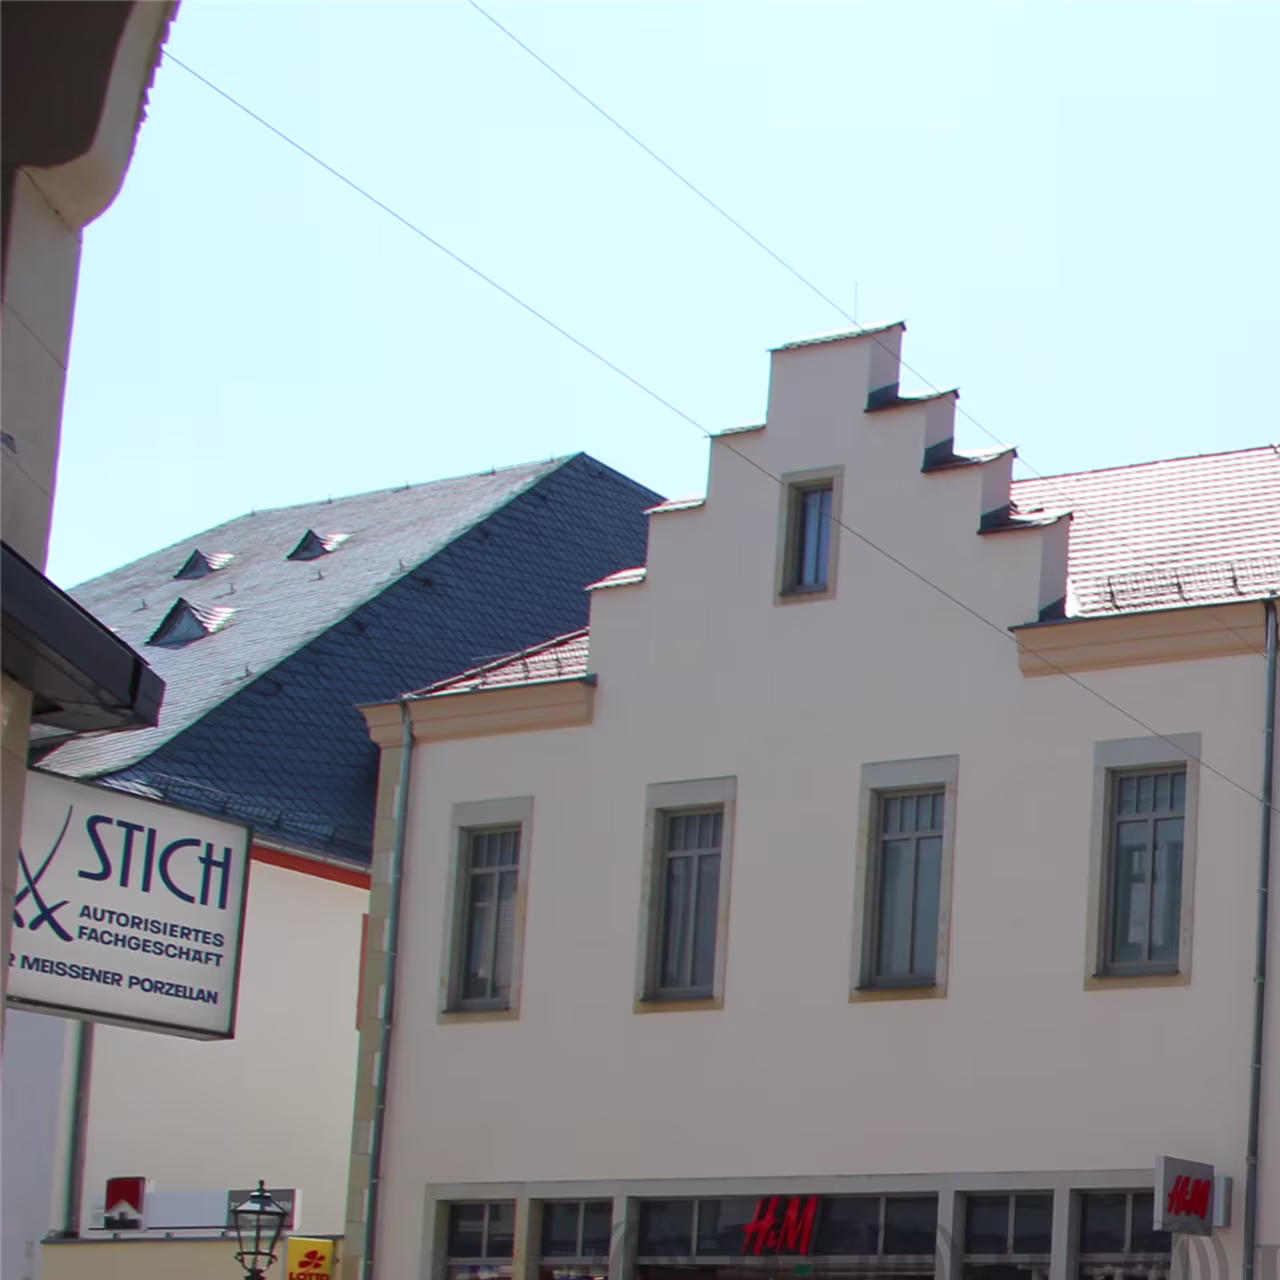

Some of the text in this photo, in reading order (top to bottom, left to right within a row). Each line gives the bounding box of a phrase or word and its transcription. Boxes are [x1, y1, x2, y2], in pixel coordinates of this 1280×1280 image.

[78, 815, 232, 910] STICH
[78, 925, 224, 967] FACHGESCHÄFT
[79, 904, 225, 948] AUTORISIERTES
[21, 955, 123, 987] MEISSENER
[128, 975, 219, 1004] PORZELLAN
[1167, 1175, 1211, 1220] H&M
[741, 1194, 819, 1257] H&M
